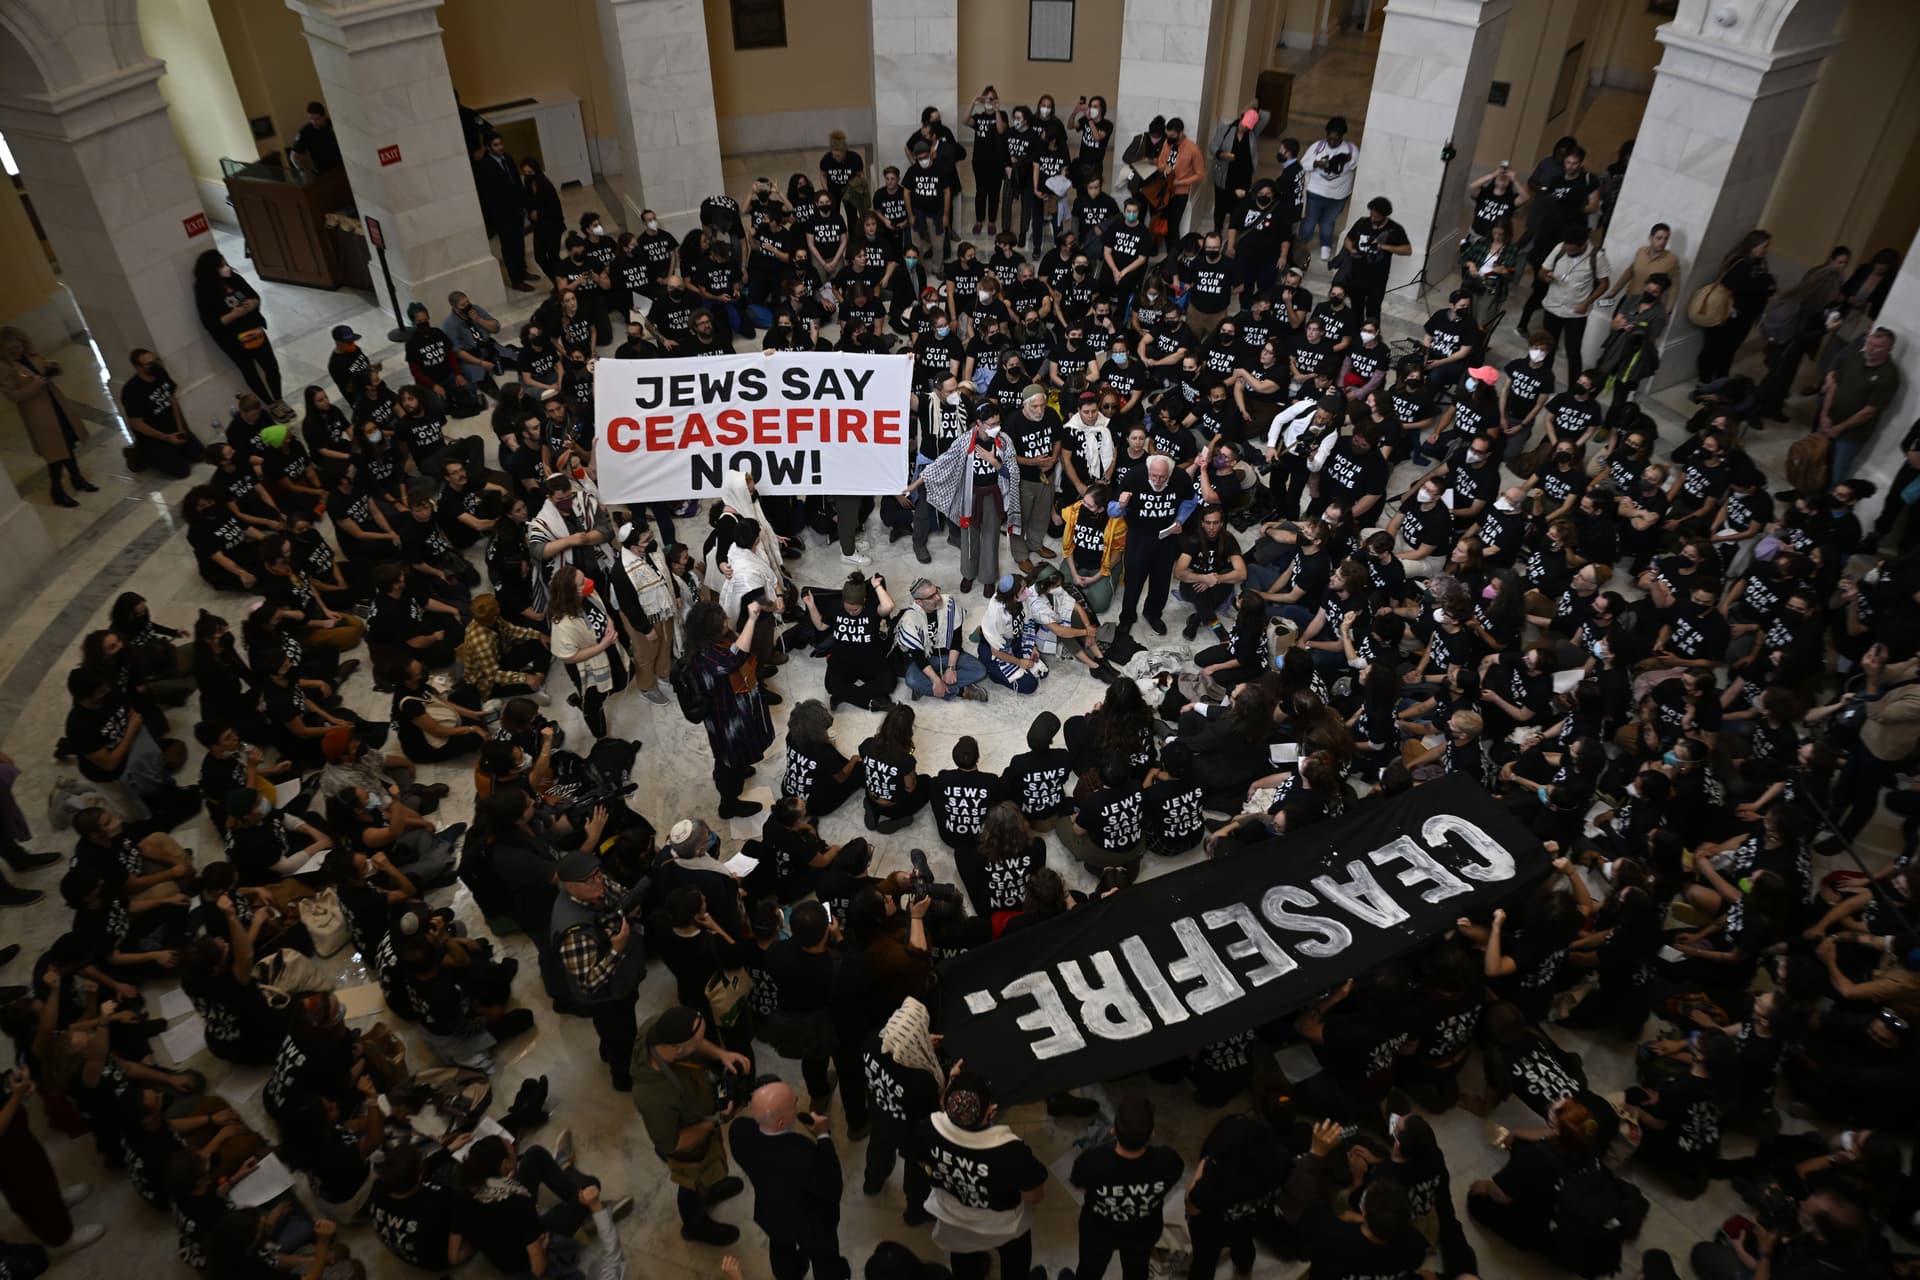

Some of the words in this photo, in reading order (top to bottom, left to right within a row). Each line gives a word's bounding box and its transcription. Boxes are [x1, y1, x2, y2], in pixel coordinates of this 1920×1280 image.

[380, 148, 399, 163] EXIT
[186, 217, 206, 233] EXIT
[1116, 232, 1130, 240] NOT
[1117, 238, 1135, 248] OUR
[623, 268, 641, 276] NOT
[629, 272, 646, 282] OUR
[1215, 272, 1224, 280] IN
[1201, 278, 1220, 286] OUR
[1335, 320, 1344, 329] IN
[1086, 340, 1106, 348] OUR
[426, 348, 445, 360] OUR
[1209, 350, 1226, 360] NOT
[1297, 349, 1313, 359] NOT
[1351, 353, 1367, 363] NOT
[1369, 358, 1378, 366] IN
[922, 358, 950, 368] NAME
[1211, 358, 1230, 368] OUR
[1298, 357, 1318, 366] OUR
[1353, 361, 1372, 372] OUR
[1108, 374, 1124, 382] NOT
[1512, 370, 1530, 383] NOT
[1531, 379, 1541, 388] IN
[636, 368, 768, 409] JEWS
[782, 368, 875, 402] SAY
[1111, 381, 1131, 391] OUR
[1513, 380, 1534, 394] OUR
[998, 390, 1014, 398] NOT
[1410, 401, 1420, 411] IN
[1456, 402, 1470, 414] NOT
[1472, 412, 1482, 422] IN
[1456, 412, 1474, 426] OUR
[1558, 406, 1577, 416] NOT
[1580, 413, 1592, 421] IN
[1561, 414, 1584, 426] OUR
[607, 408, 901, 453] CEASEFIRE
[1022, 432, 1041, 443] NOT
[1044, 427, 1052, 435] IN
[1028, 437, 1051, 448] OUR
[1170, 442, 1180, 451] IN
[1334, 453, 1352, 466] NOT
[1352, 464, 1362, 473] IN
[691, 450, 822, 491] NOW!
[1334, 462, 1354, 478] OUR
[1561, 481, 1572, 492] IN
[1139, 493, 1162, 502] NOT
[1144, 501, 1171, 509] OUR
[1139, 508, 1176, 518] NAME
[1074, 524, 1094, 534] NOT
[1415, 522, 1424, 532] IN
[1077, 532, 1100, 544] OUR
[836, 616, 857, 625] NOT
[858, 617, 870, 625] IN
[838, 625, 865, 634] OUR
[832, 630, 872, 644] NAME
[864, 756, 898, 776] JEWS
[1024, 768, 1065, 783] JEWS
[1028, 778, 1060, 791] SAY
[944, 786, 988, 799] JEWS
[949, 797, 982, 808] SAY
[1101, 792, 1142, 817] JEWS
[1162, 788, 1203, 810] JEWS
[945, 804, 987, 816] CEASE
[1169, 800, 1199, 818] SAY
[950, 815, 980, 825] FIRE
[1108, 805, 1139, 826] SAY
[945, 820, 985, 834] NOW
[1110, 824, 1139, 839] FIRE
[1104, 828, 1142, 849] NOW
[992, 868, 1026, 882] SAY
[963, 814, 1517, 1061] CEASEFIRE.
[931, 1146, 989, 1177] JEWS
[937, 1162, 979, 1185] SAY
[1096, 1181, 1166, 1197] JEWS
[1104, 1194, 1155, 1207] SAY
